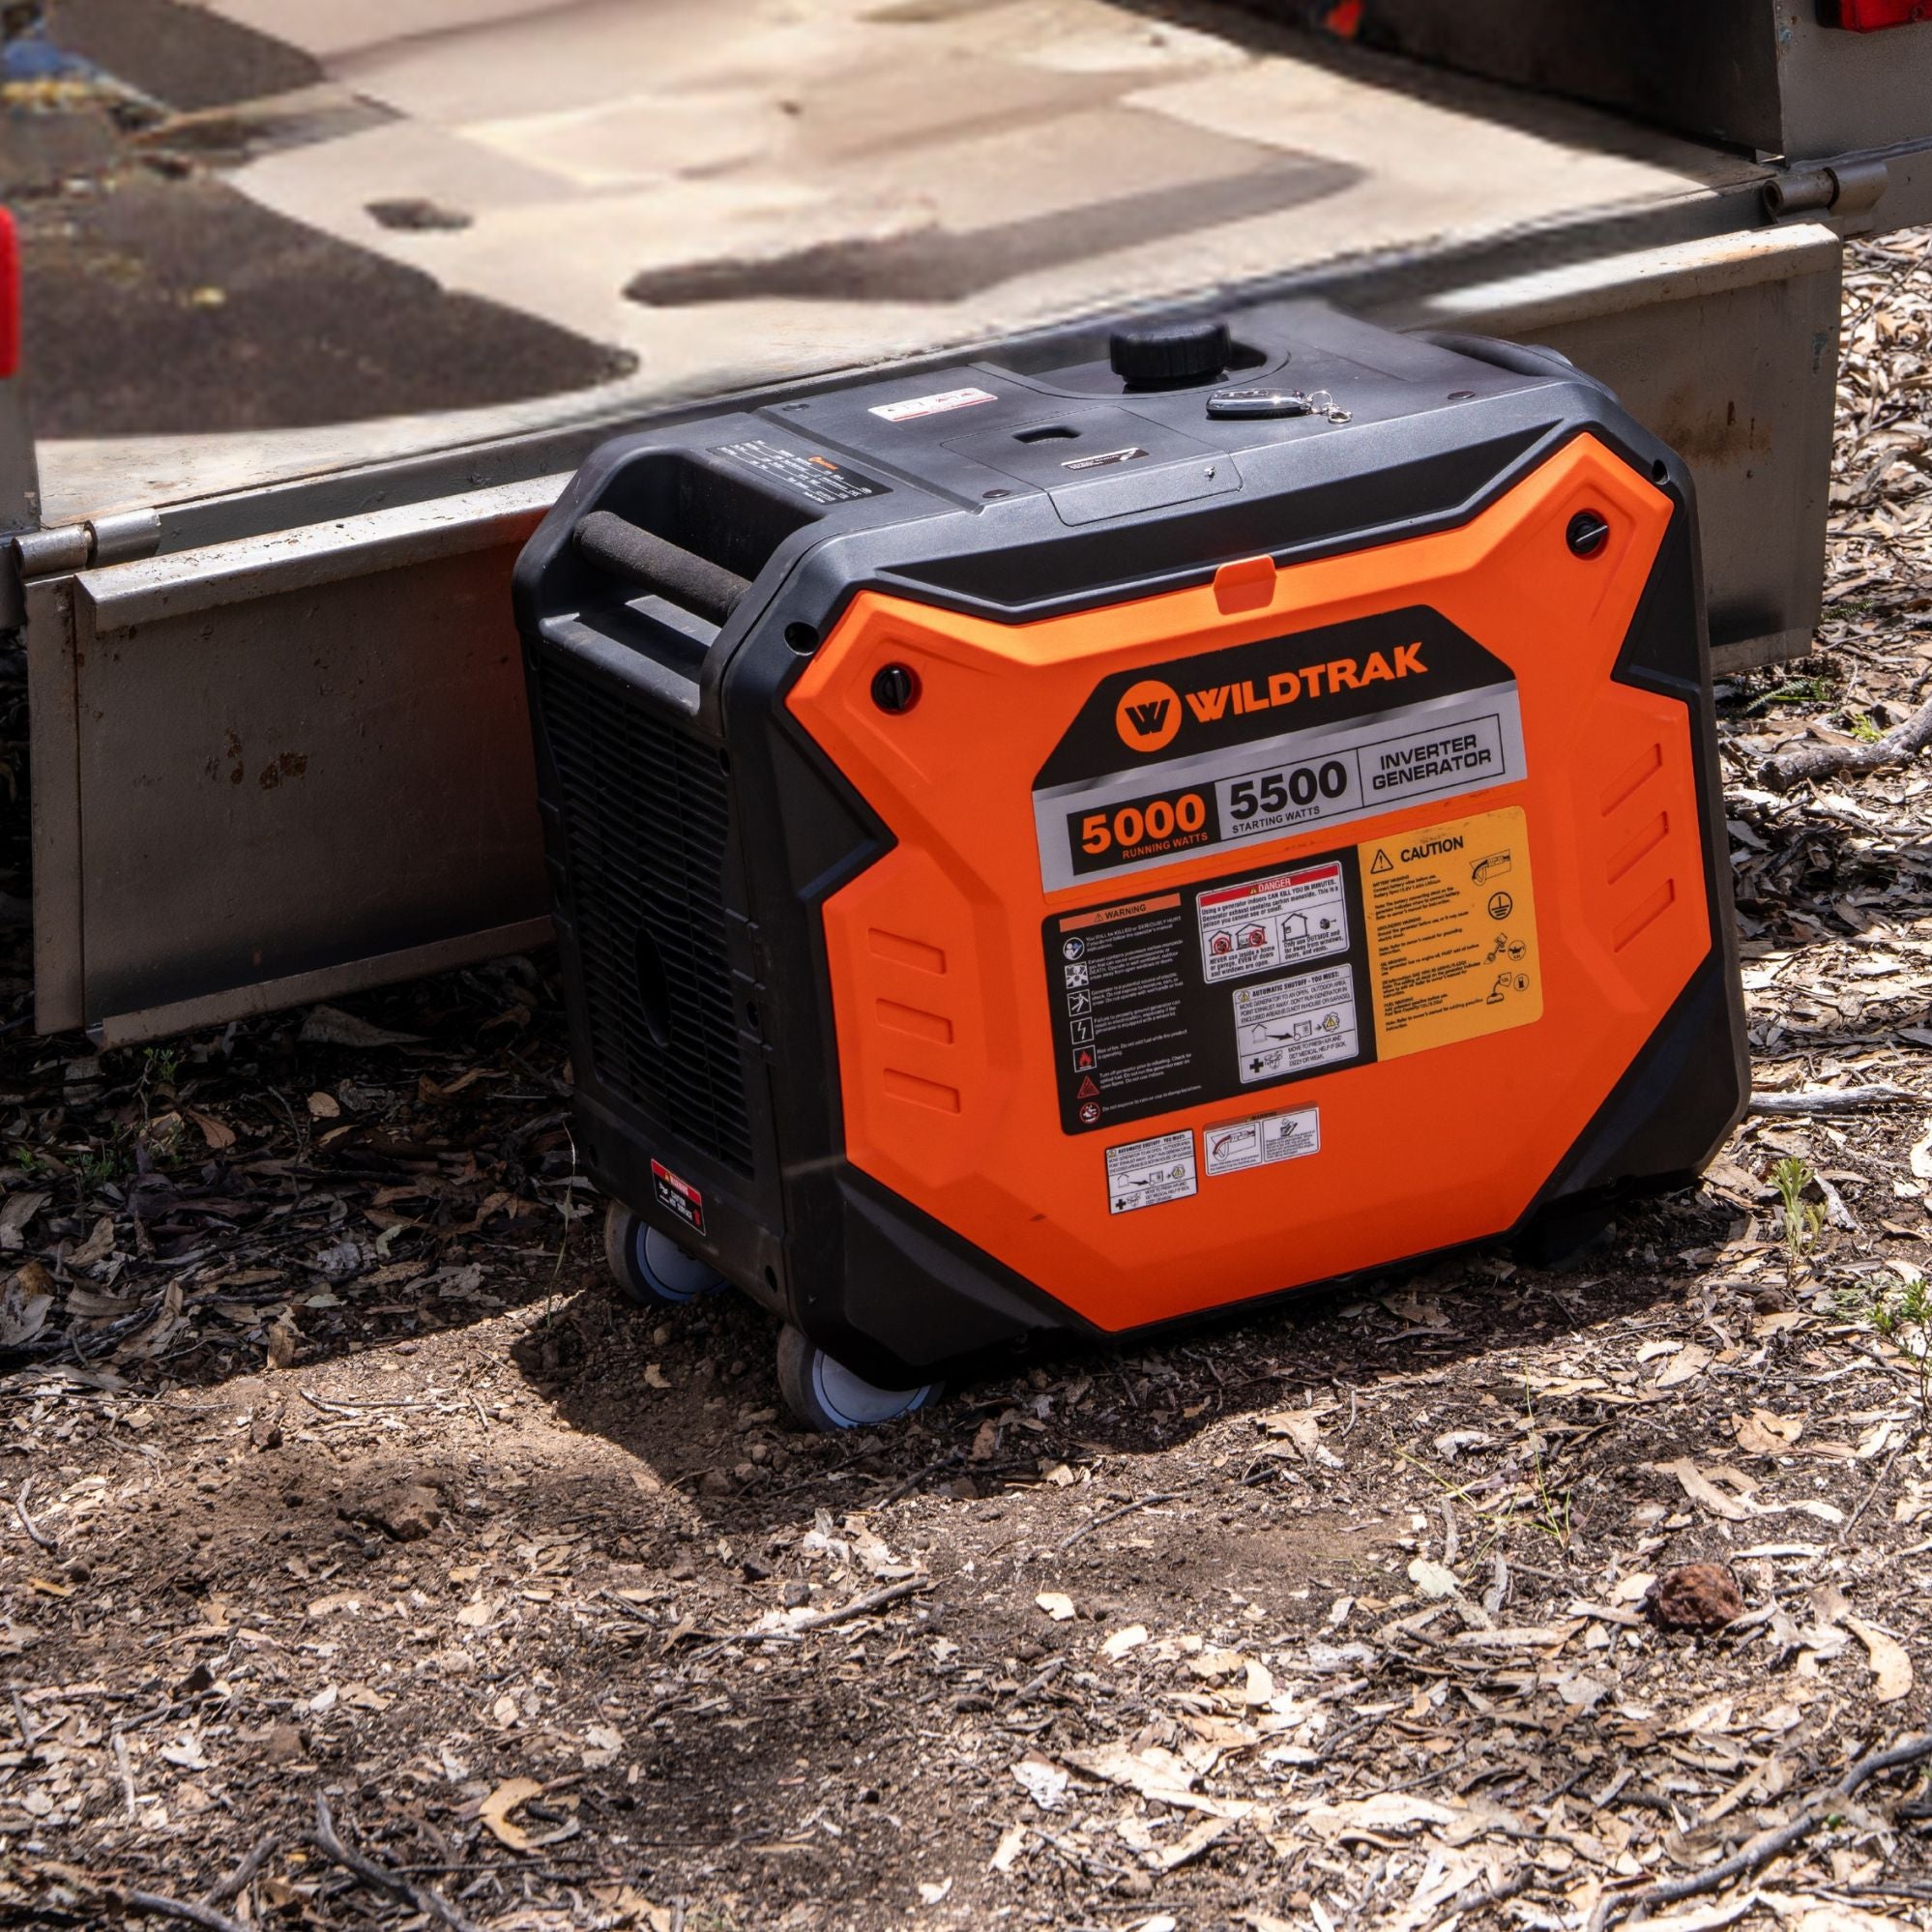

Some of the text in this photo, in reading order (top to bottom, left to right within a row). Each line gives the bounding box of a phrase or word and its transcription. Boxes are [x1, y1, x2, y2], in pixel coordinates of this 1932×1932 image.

[1185, 642, 1428, 723] WILDTRAK
[1380, 733, 1477, 770] INVERTER
[1371, 747, 1491, 791] GENERATOR
[1227, 757, 1348, 822] 5500
[1079, 790, 1208, 857] 5000
[1232, 805, 1320, 834] STARTING WATTS
[1122, 831, 1208, 860] RUNNING WATTS
[1400, 835, 1464, 863] CAUTION
[1258, 877, 1291, 893] DANGER
[1105, 903, 1146, 920] WARNING
[1252, 984, 1282, 997] AUTOMATIC
[1283, 979, 1306, 989] SHUTOFF
